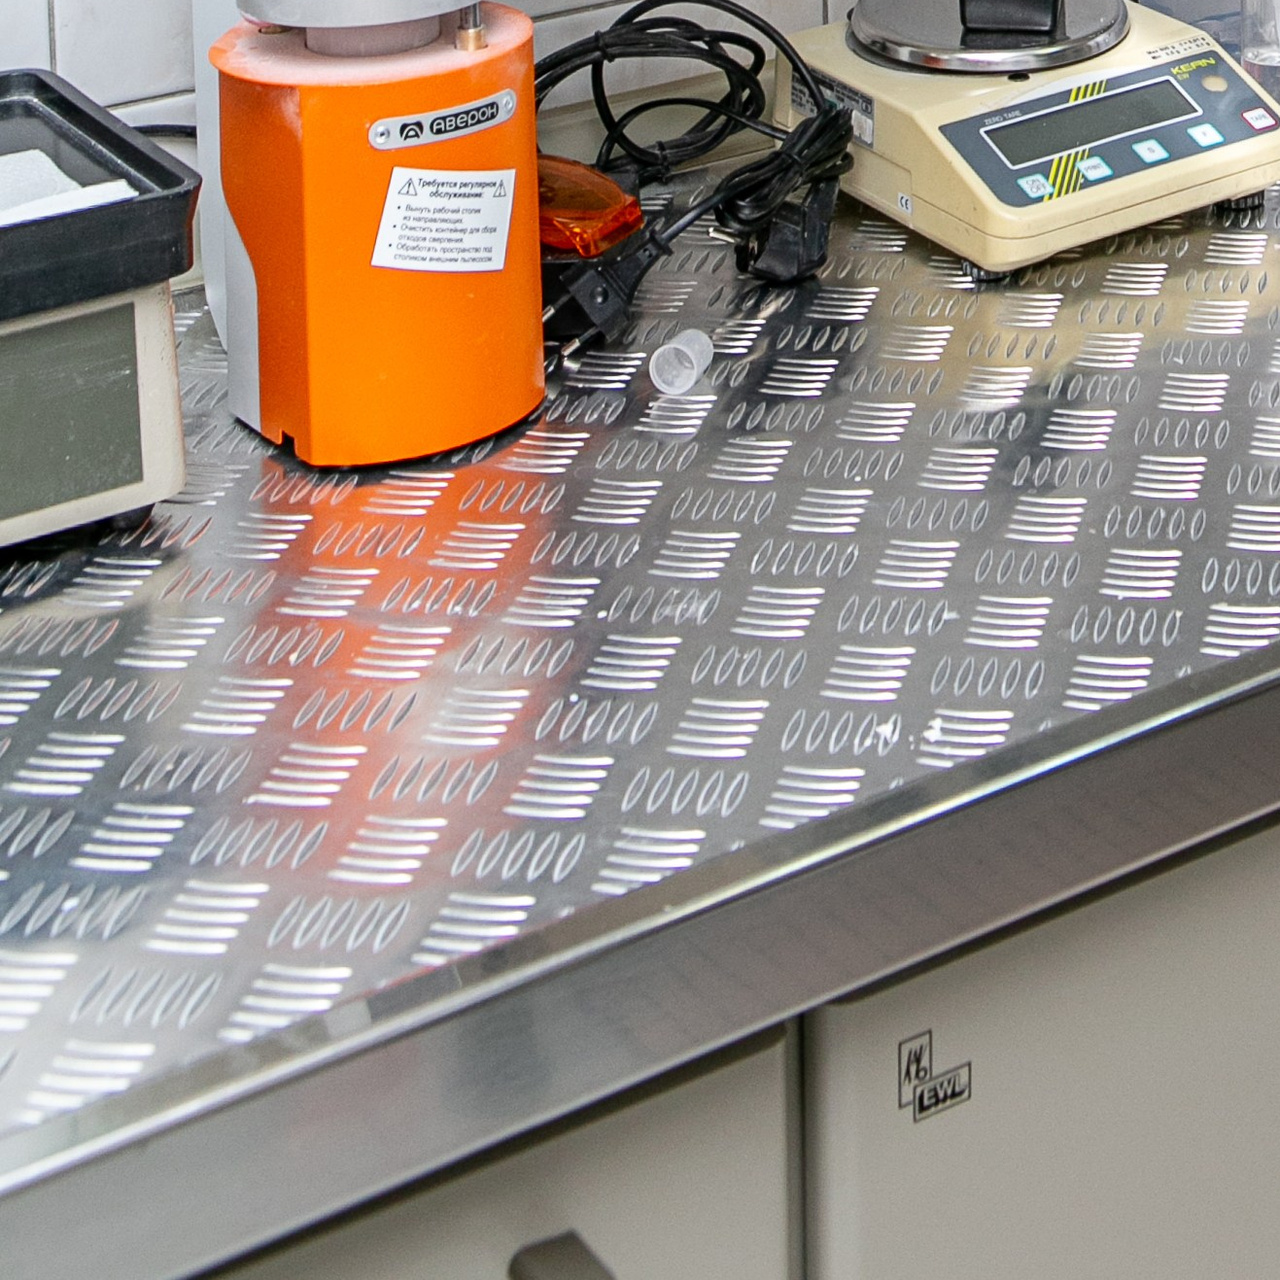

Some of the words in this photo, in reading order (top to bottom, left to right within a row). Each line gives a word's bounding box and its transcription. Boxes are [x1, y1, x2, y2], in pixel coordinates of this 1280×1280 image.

[1170, 57, 1216, 75] KERN
[418, 178, 457, 190] Требуется
[405, 204, 431, 214] Вынуть
[433, 205, 460, 215] рабочий
[401, 223, 433, 233] Очистить
[396, 242, 438, 252] Обработать
[918, 1072, 968, 1114] EWL
